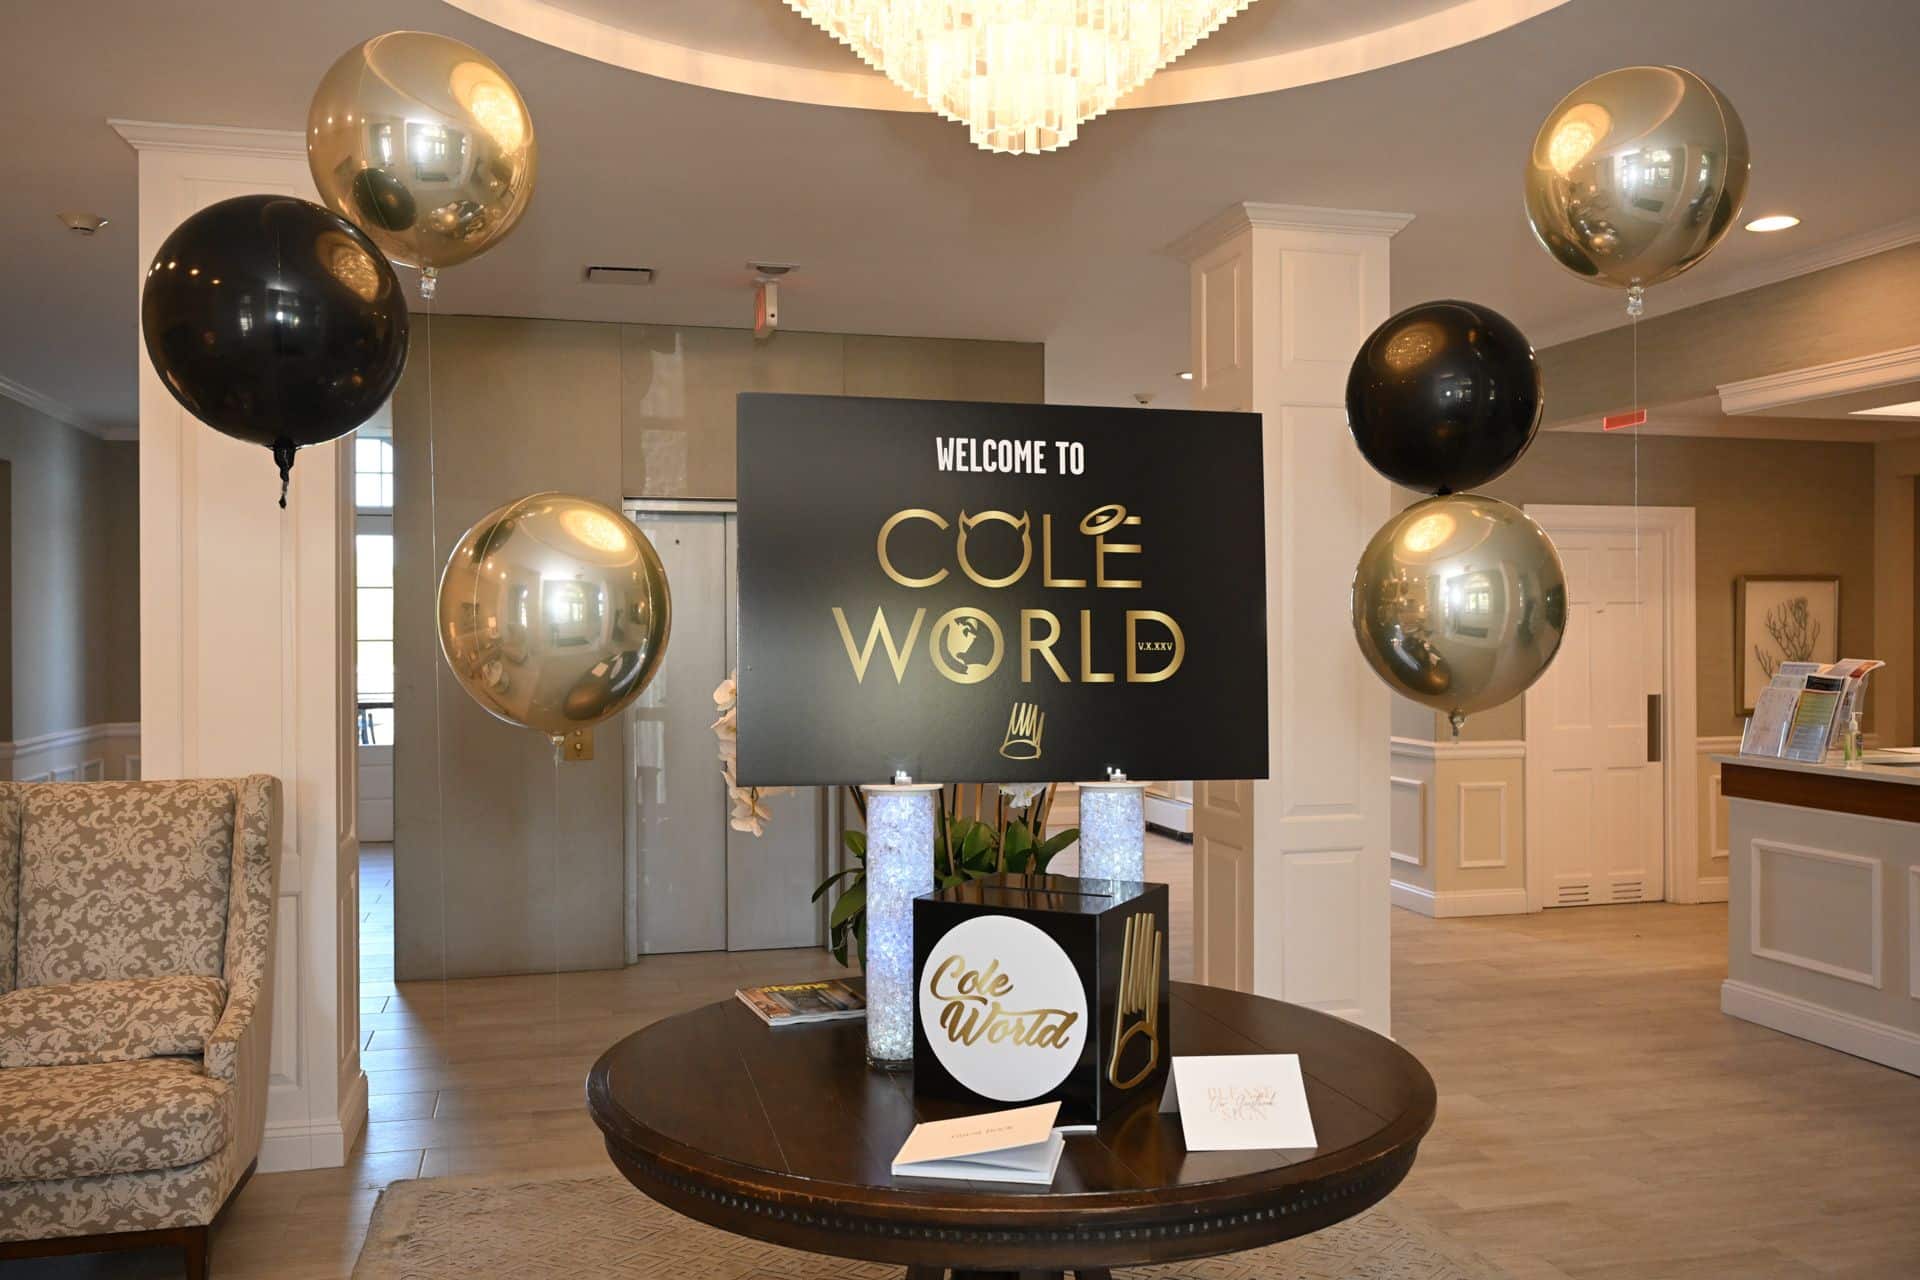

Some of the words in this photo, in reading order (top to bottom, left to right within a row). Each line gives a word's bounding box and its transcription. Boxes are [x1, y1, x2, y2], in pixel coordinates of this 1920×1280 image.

[936, 437, 1046, 475] WELCOME
[1056, 442, 1084, 475] TO
[878, 505, 1141, 588] COLE
[832, 606, 1185, 684] WORLD
[1137, 641, 1173, 651] V.X.XXV
[931, 955, 1013, 1004] Cole
[940, 1000, 1077, 1049] World
